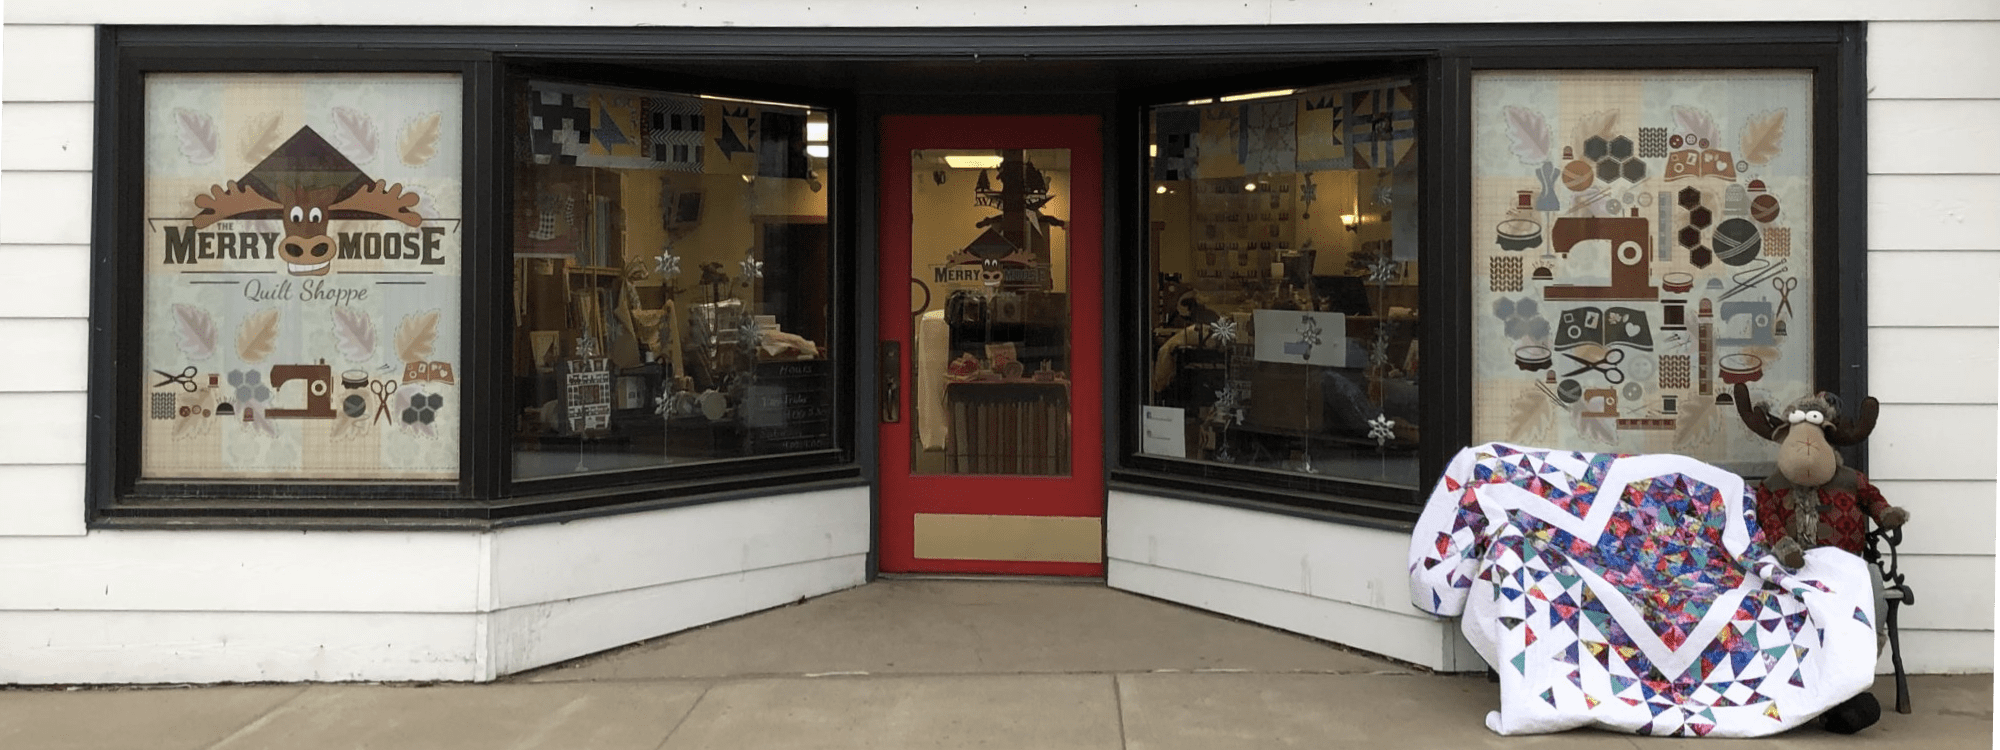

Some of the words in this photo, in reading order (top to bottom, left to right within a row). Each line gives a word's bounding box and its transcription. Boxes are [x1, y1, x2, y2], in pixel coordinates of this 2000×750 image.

[217, 222, 235, 231] THE
[163, 226, 281, 264] MERRY
[337, 226, 446, 265] MOOSE
[934, 267, 980, 283] MERRY
[243, 279, 292, 301] Quilt
[298, 279, 368, 306] Shoppe
